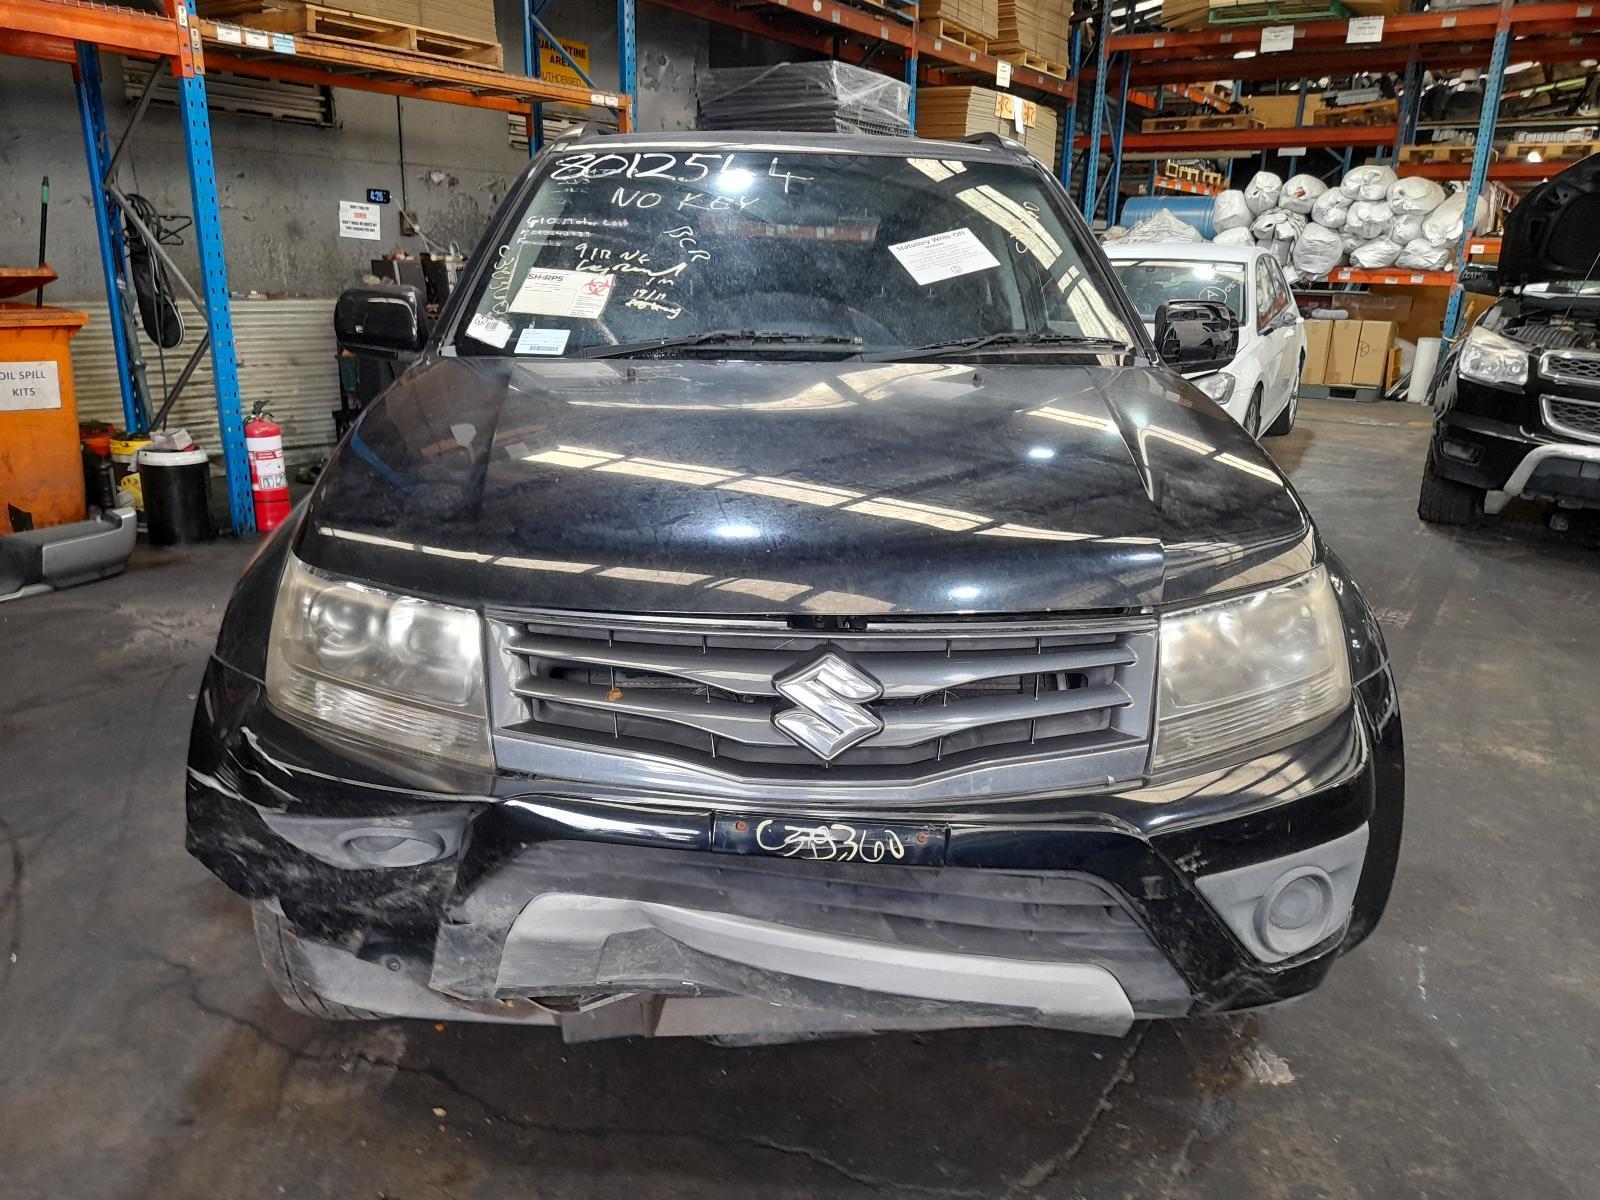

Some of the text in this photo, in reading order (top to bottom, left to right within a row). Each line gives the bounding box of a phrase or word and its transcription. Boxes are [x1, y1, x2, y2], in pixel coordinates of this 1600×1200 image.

[550, 54, 570, 68] ARE
[611, 186, 661, 209] NO
[0, 370, 47, 381] OIL SPILL
[12, 387, 36, 397] KITS
